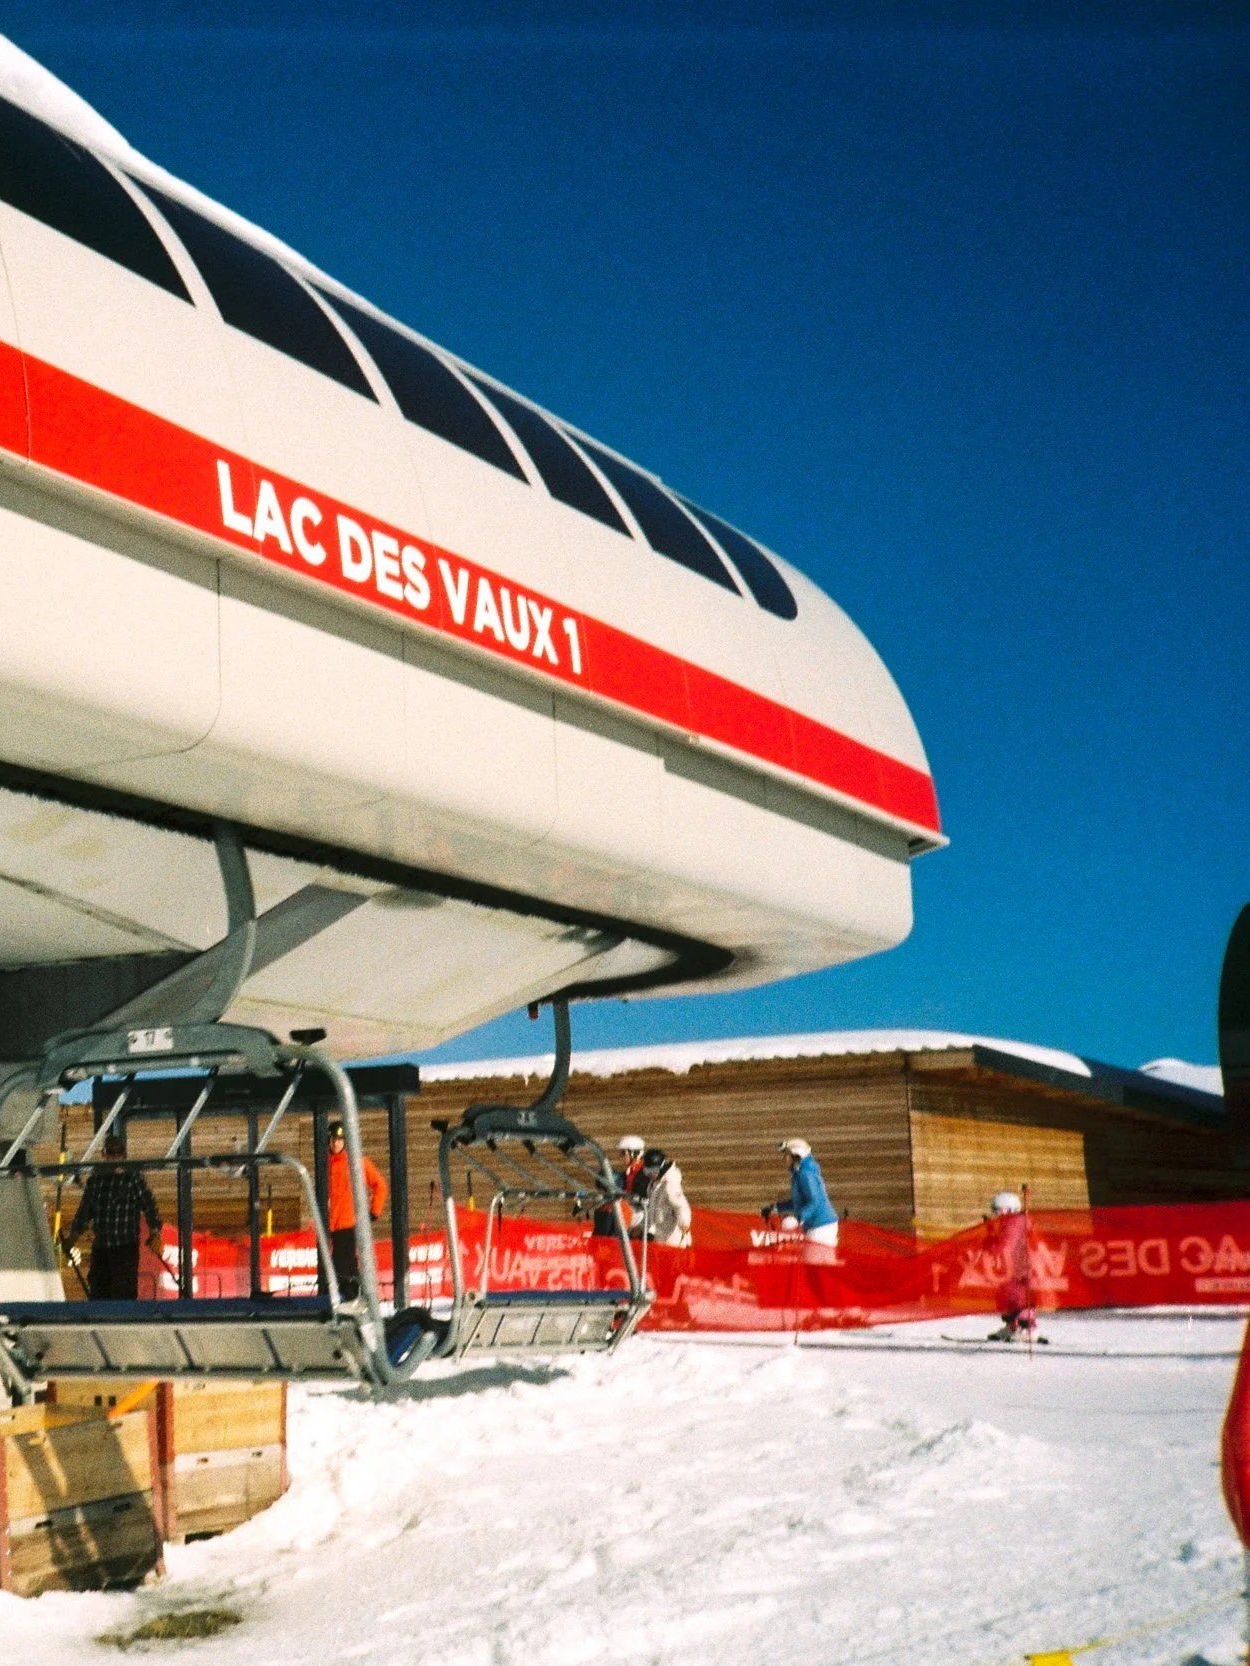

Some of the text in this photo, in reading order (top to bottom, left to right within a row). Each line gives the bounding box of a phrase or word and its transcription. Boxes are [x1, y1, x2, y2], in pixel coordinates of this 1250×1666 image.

[217, 459, 581, 674] LAC DES VAUX 1
